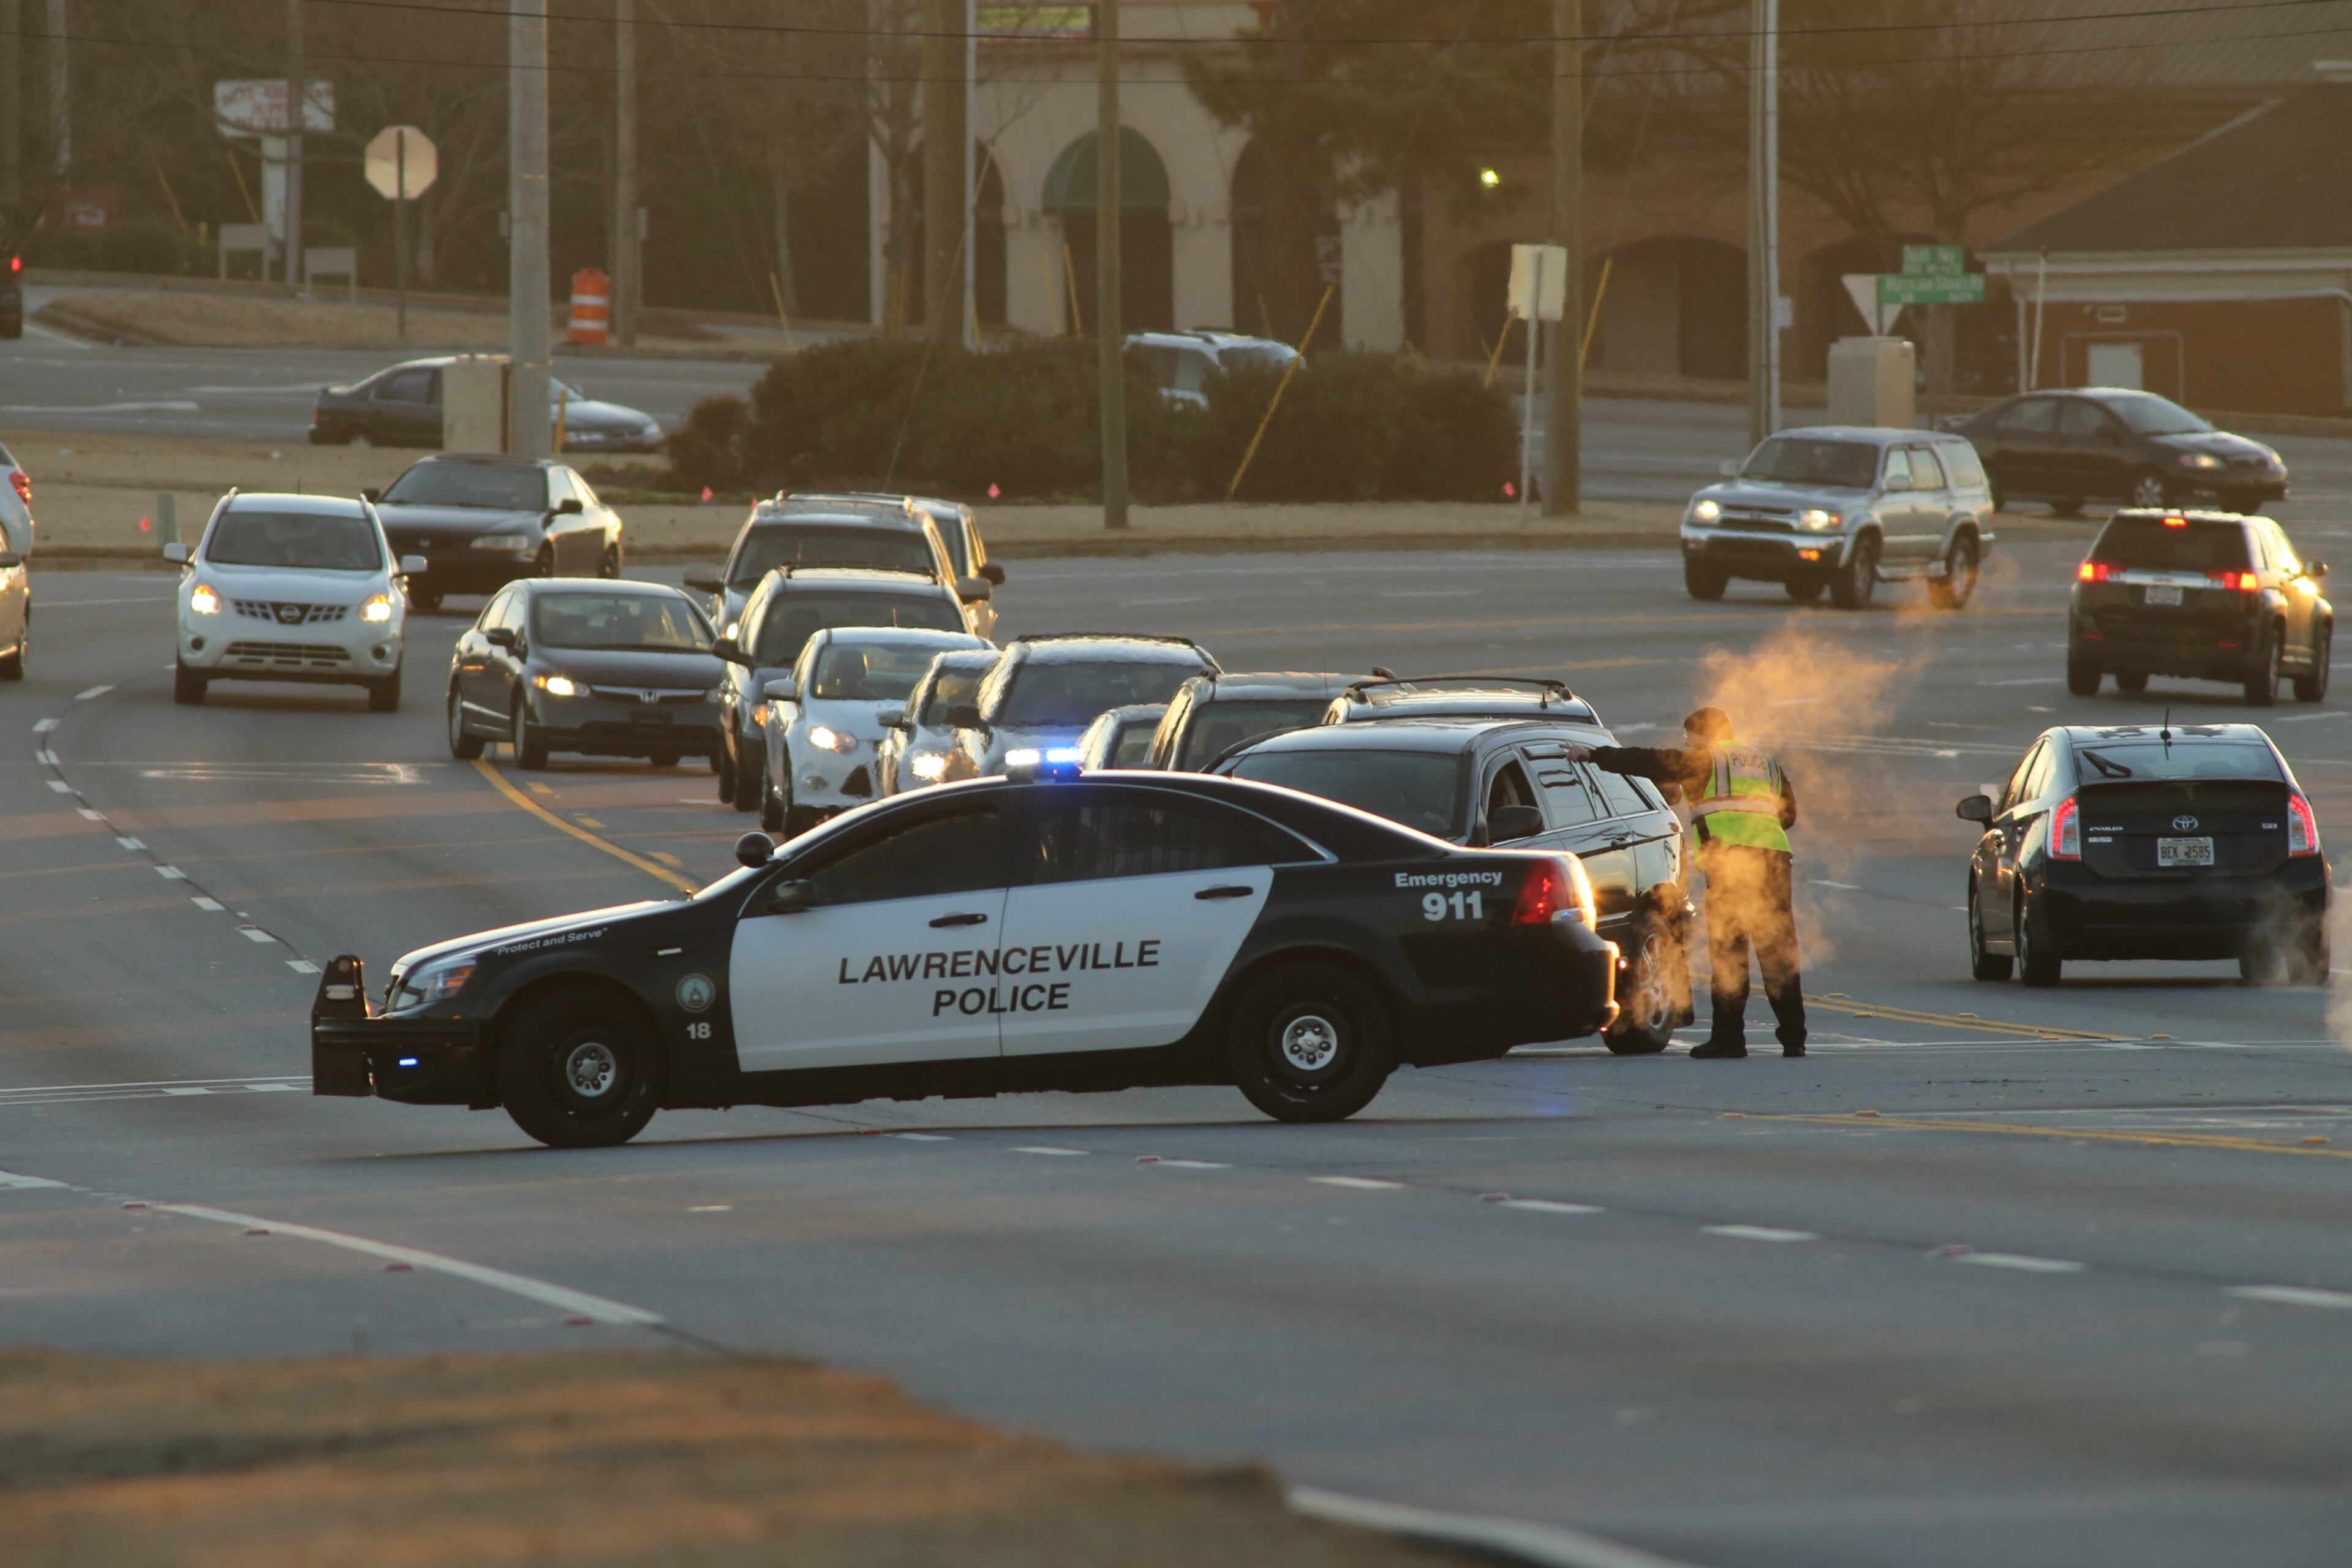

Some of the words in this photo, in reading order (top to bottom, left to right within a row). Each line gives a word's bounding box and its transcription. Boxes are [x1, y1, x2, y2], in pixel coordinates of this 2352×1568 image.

[1730, 752, 1768, 770] POLICE
[2161, 846, 2179, 859] BEK
[1395, 871, 1503, 889] Emergency
[1422, 891, 1483, 922] 911
[542, 934, 567, 948] and
[838, 939, 1161, 984] LAWRENCEVILLE
[932, 982, 1072, 1017] POLICE
[686, 1022, 712, 1039] 18
